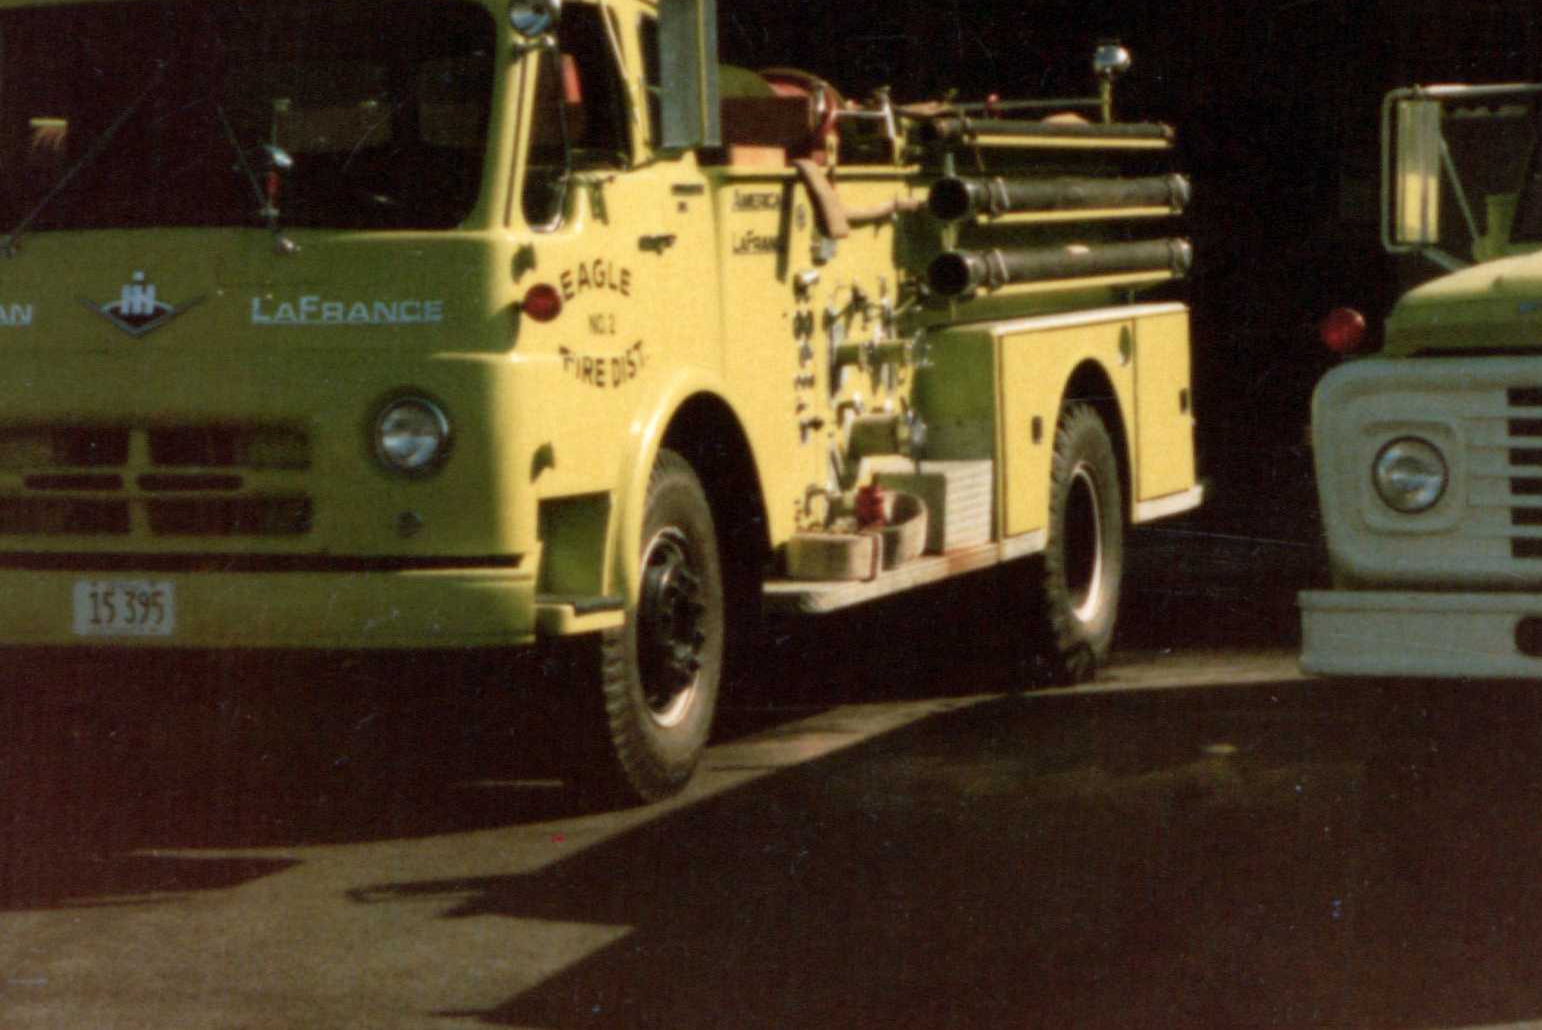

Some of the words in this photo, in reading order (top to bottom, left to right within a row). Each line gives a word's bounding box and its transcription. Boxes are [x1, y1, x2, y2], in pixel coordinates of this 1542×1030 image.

[560, 257, 632, 302] EAGLE
[559, 345, 606, 388] FIRE
[88, 590, 116, 625] 15
